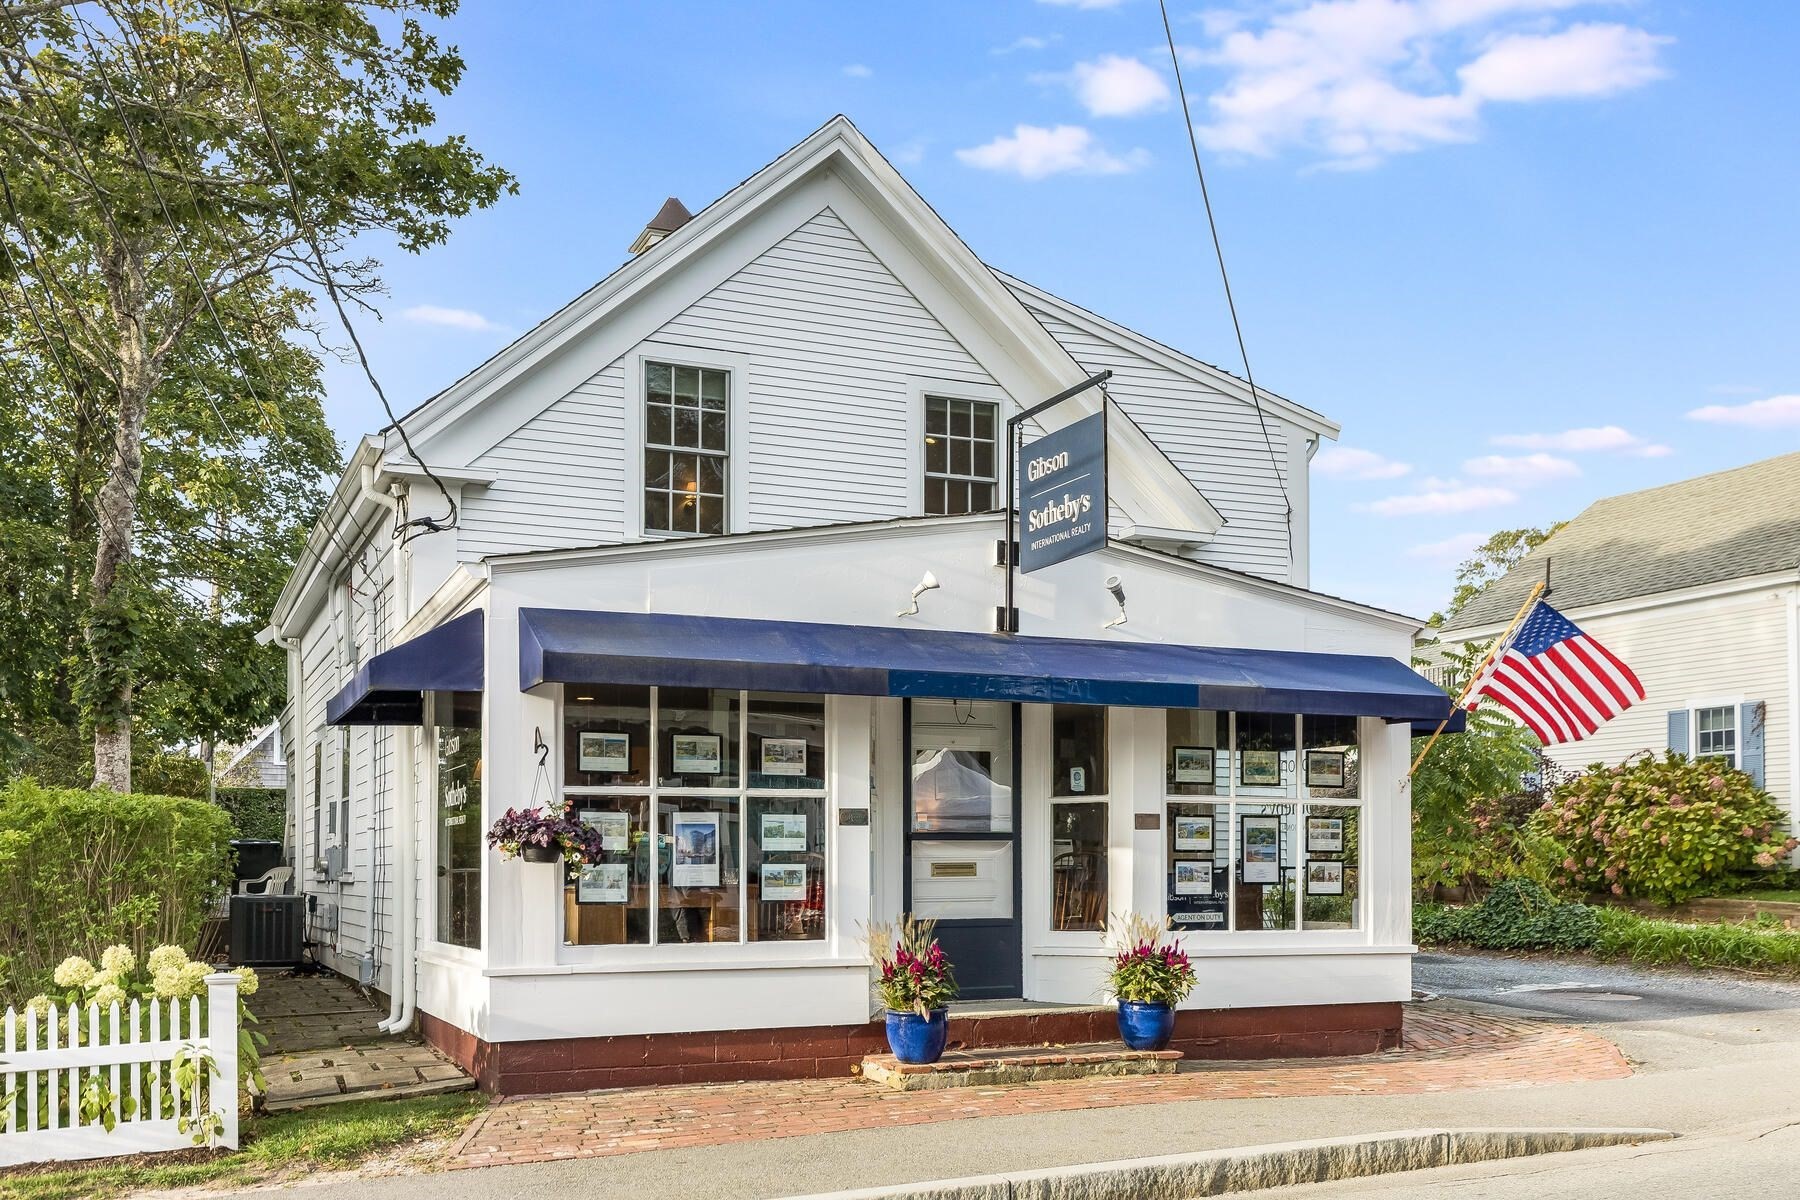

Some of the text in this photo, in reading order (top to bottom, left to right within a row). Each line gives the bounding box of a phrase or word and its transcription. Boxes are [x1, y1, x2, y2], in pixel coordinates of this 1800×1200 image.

[1028, 452, 1068, 481] Gibson
[1029, 494, 1090, 532] Sotheby's
[1031, 522, 1091, 551] INTERNATIONAL REALTY
